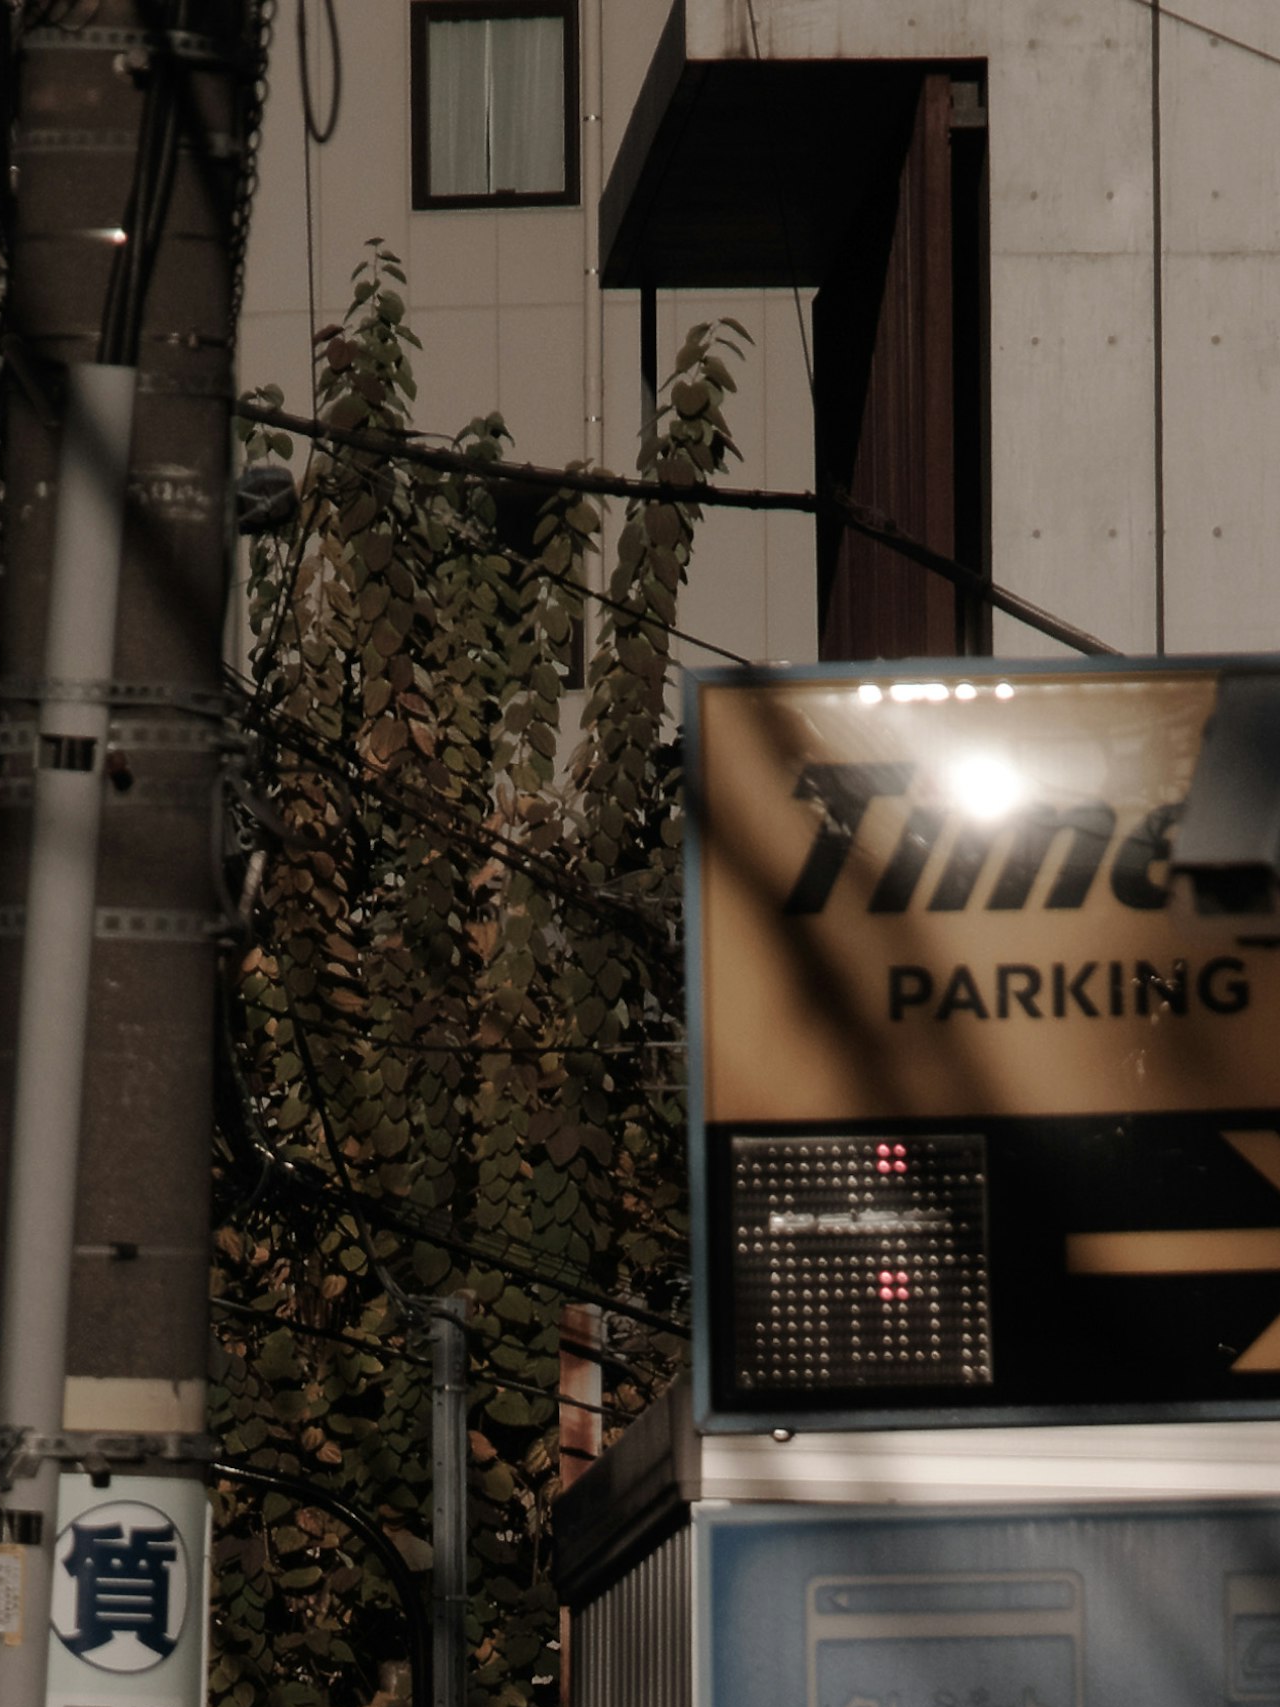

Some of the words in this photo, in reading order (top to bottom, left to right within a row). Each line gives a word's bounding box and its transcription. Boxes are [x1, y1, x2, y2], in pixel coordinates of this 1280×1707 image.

[781, 762, 1182, 916] Time
[889, 956, 1250, 1022] PARKING
[62, 1522, 177, 1656] 質
